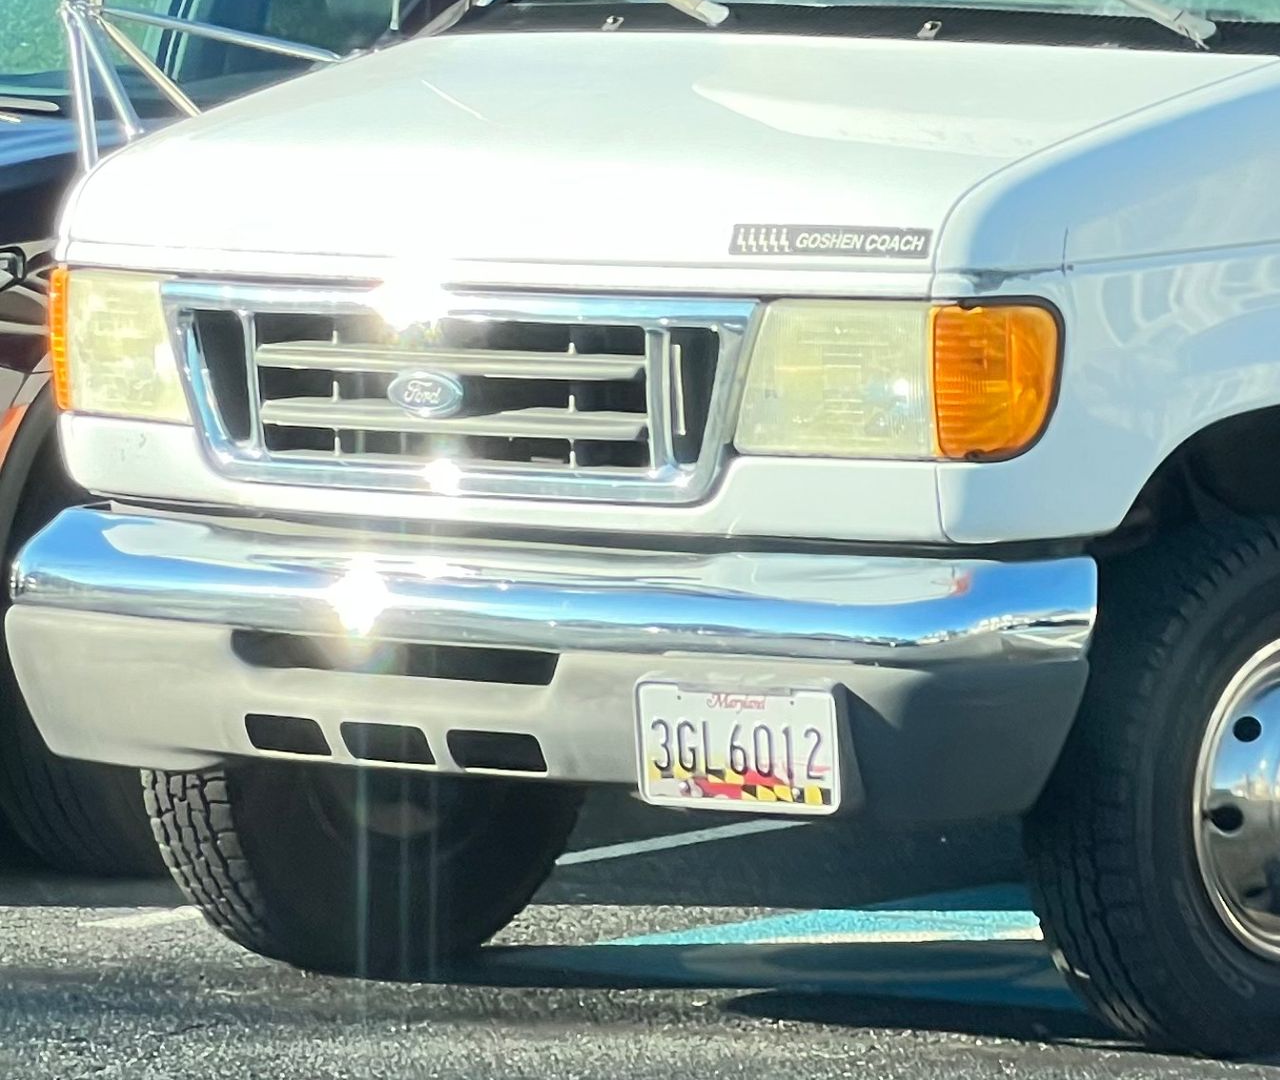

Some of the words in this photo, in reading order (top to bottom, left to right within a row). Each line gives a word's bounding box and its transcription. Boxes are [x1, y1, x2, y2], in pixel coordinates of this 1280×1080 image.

[795, 231, 864, 250] GOSHEN
[864, 233, 925, 252] COACH
[403, 380, 442, 405] Ford
[650, 717, 826, 784] 3GL6012
